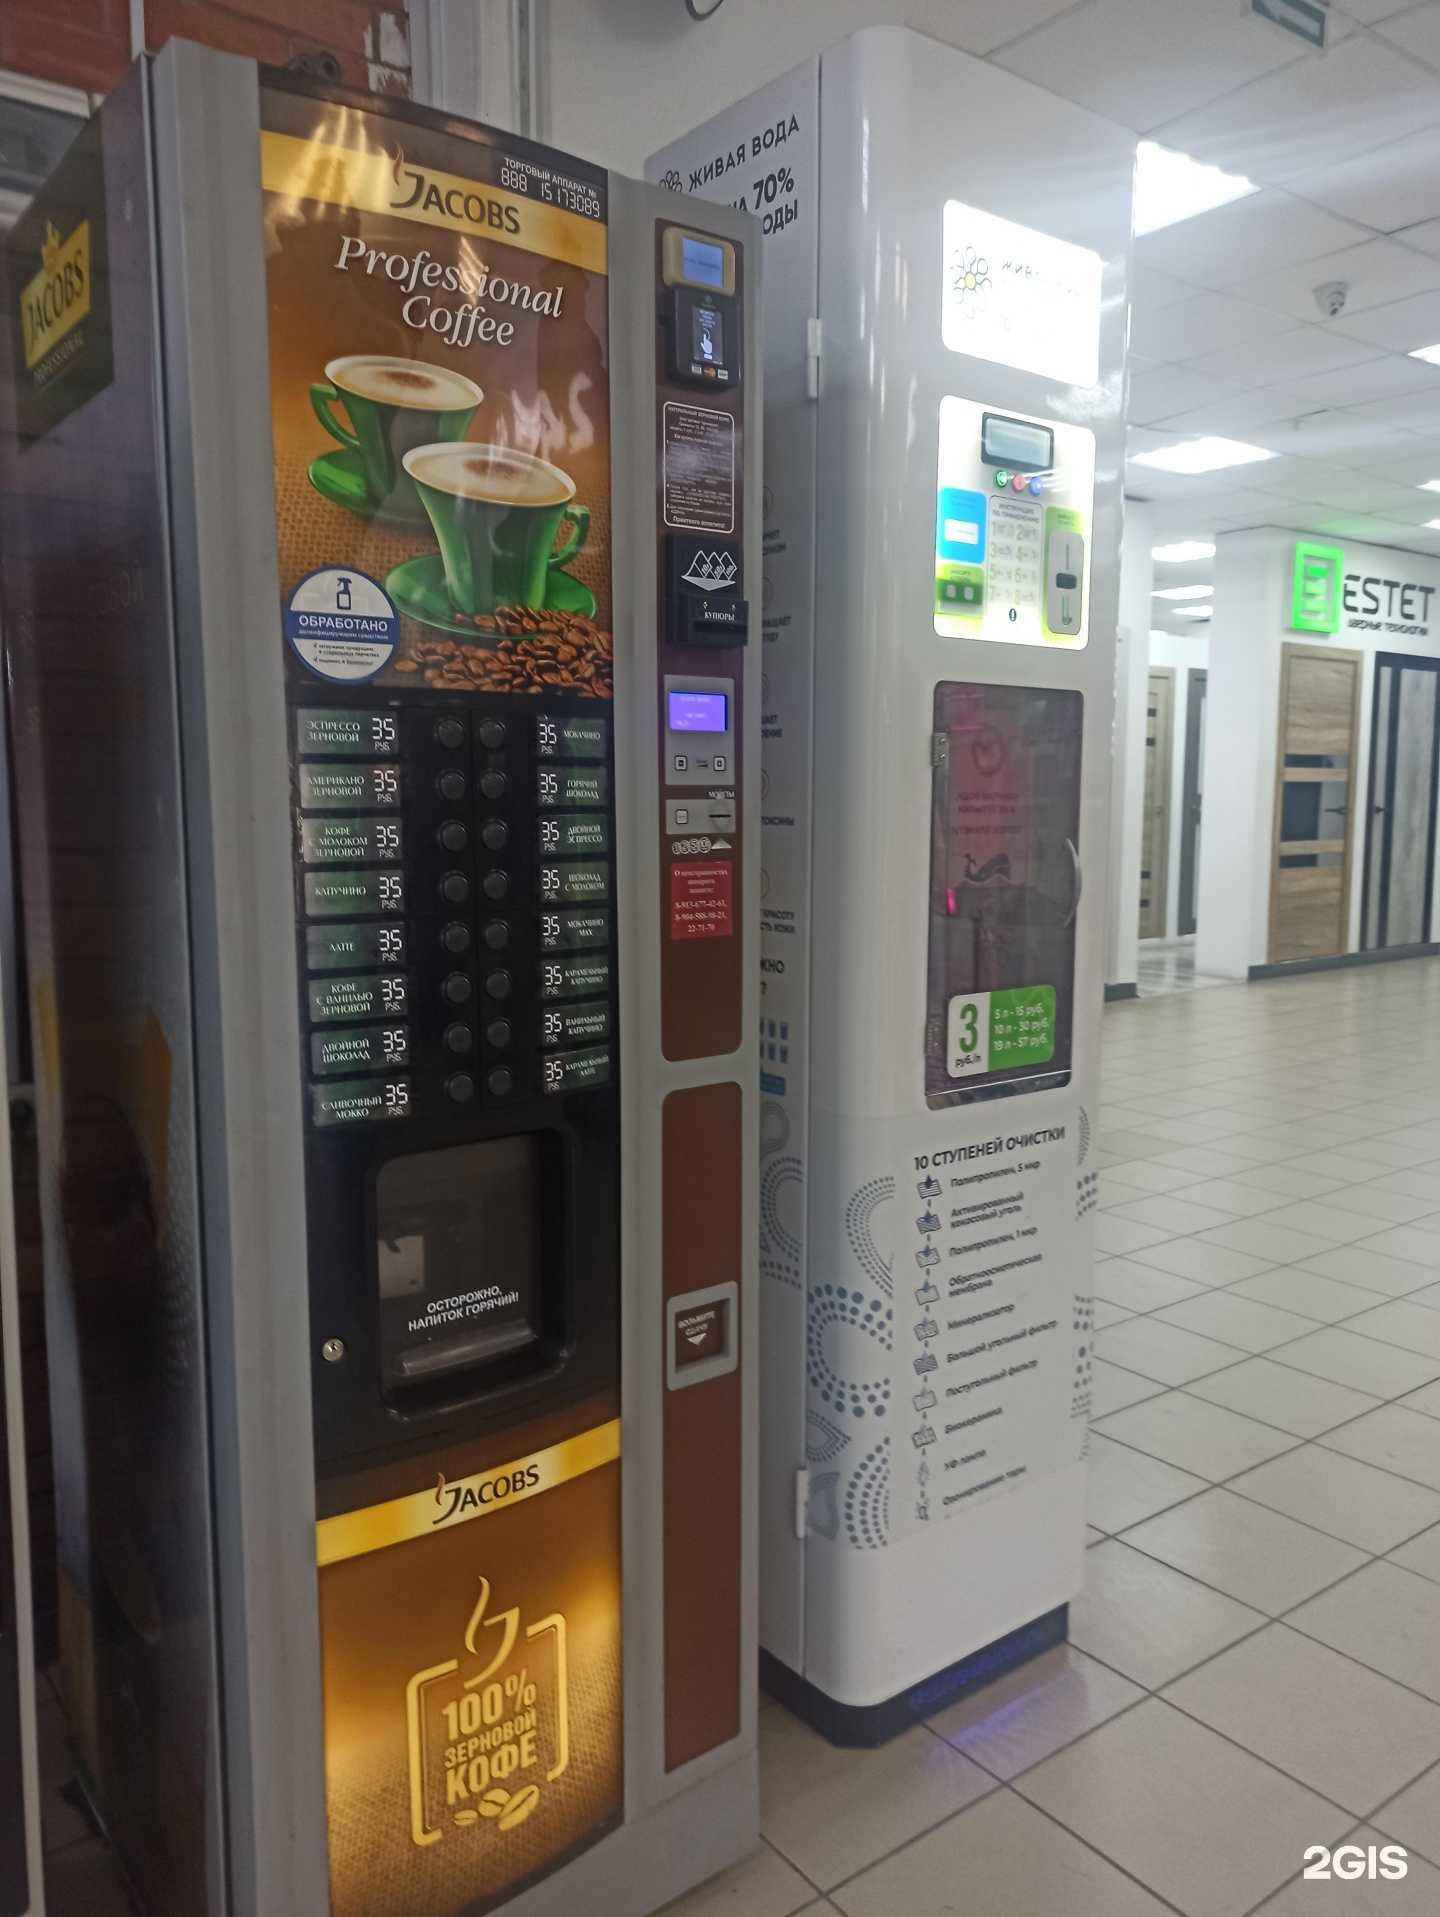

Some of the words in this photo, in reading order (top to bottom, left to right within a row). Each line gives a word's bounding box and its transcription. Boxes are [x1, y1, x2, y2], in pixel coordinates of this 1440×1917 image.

[688, 144, 746, 192] ЖИВАЯ
[752, 114, 799, 156] ВОДА
[501, 168, 527, 192] 888
[504, 157, 550, 181] ТОРГОВЫЙ
[552, 175, 587, 194] АППАРАТ
[753, 167, 794, 210] 70%
[390, 171, 520, 234] JACOBS
[334, 236, 563, 317] Professional
[28, 250, 84, 347] JACOBS
[403, 296, 514, 347] Coffee
[1343, 574, 1436, 622] ESTET
[299, 615, 387, 632] ОБРАБОТАНО
[704, 611, 735, 621] КУПЮРЫ
[306, 719, 360, 731] ЭСПРЕССО
[372, 717, 395, 740] 35
[308, 731, 359, 742] ЗЕРНОВОЙ
[539, 723, 557, 745] 35
[307, 775, 365, 786] АМЕРИКАНО
[373, 770, 397, 792] 35
[312, 786, 362, 797] ЗЕРНОВОЙ
[540, 773, 558, 794] 35
[319, 837, 368, 847] МОЛОКОМ
[325, 827, 350, 836] КОФЕ
[376, 825, 399, 848] 35
[542, 821, 560, 841] 35
[568, 834, 602, 844] ЭСПРЕССО
[314, 847, 365, 857] ЗЕРНОВОЙ
[315, 886, 367, 897] КАПУЧИНО
[379, 876, 402, 898] 35
[542, 869, 560, 889] 35
[542, 916, 560, 936] 35
[328, 943, 354, 952] ЛАТТЕ
[379, 929, 402, 951] 35
[545, 965, 562, 986] 35
[326, 992, 373, 1004] ВАНИЛЬЮ
[331, 983, 357, 994] КОФЕ
[381, 978, 405, 1000] 35
[320, 1002, 371, 1016] ЗЕРНОВОЙ
[994, 1009, 1000, 1019] 5
[545, 1013, 562, 1033] 35
[960, 1003, 978, 1053] 3
[322, 1038, 370, 1053] ДВОЙНОЙ
[383, 1030, 406, 1052] 35
[322, 1050, 371, 1064] ШОКОЛАД
[546, 1060, 563, 1081] 35
[321, 1095, 382, 1111] СЛИВОЧНЫЙ
[385, 1083, 409, 1105] 35
[336, 1108, 369, 1120] МОККО
[914, 1155, 929, 1170] 10
[932, 1136, 1004, 1166] СТУПЕНЕЙ
[1006, 1126, 1066, 1151] ОЧИСТКИ
[1017, 1162, 1023, 1173] 5
[427, 1285, 502, 1314] ОСТОРОЖНО,
[408, 1308, 463, 1332] НАПИТОК
[432, 1464, 540, 1525] JACOBS
[441, 1668, 536, 1741] 100%
[444, 1707, 536, 1768] ЗЕРНОВОЙ
[446, 1729, 538, 1805] КОФЕ
